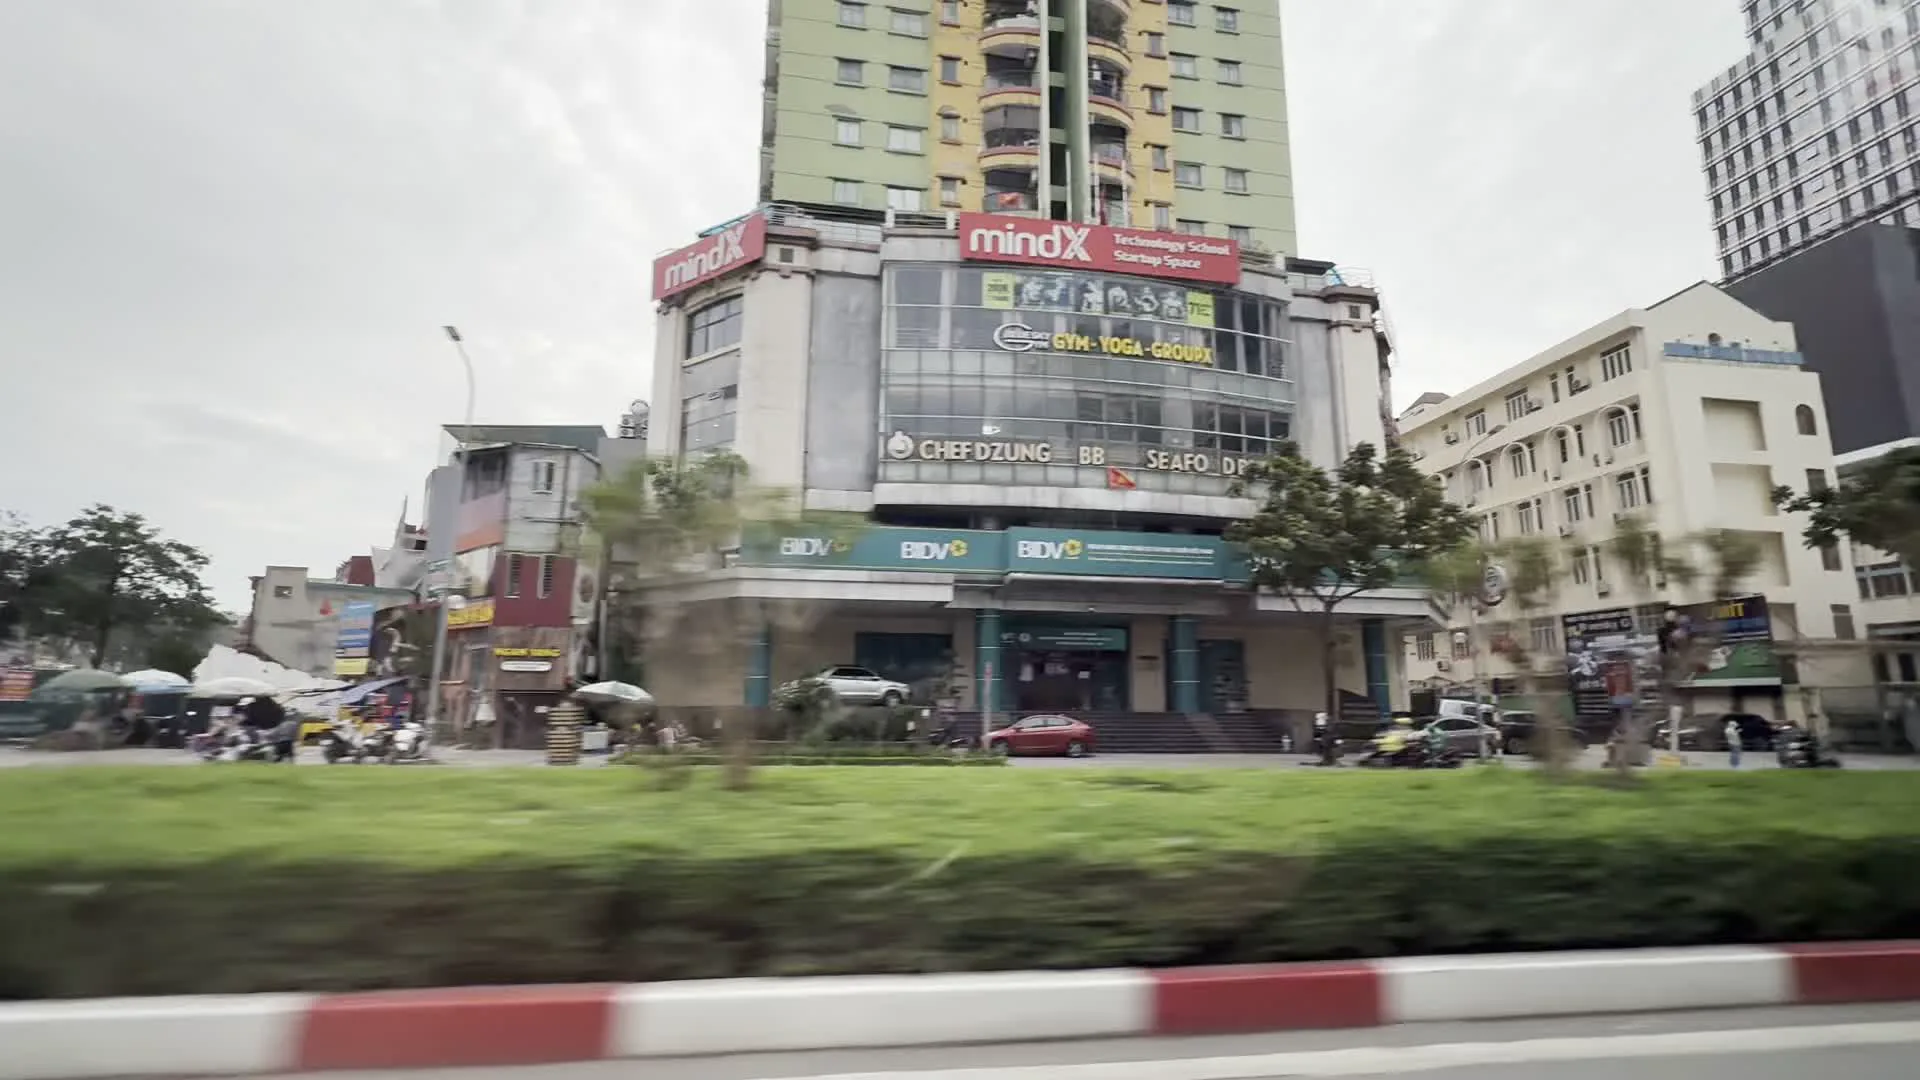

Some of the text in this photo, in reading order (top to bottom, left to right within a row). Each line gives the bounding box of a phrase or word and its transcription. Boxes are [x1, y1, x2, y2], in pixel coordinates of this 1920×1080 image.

[969, 223, 1092, 262] mindX
[1113, 233, 1230, 255] Technology School
[664, 223, 746, 290] mindX
[1113, 249, 1201, 269] Startup Space
[1079, 446, 1105, 465] BB
[1147, 449, 1209, 472] SEAFO
[779, 537, 832, 556] BIDV
[901, 541, 950, 560] BIDV
[1017, 540, 1065, 560] BIDV
